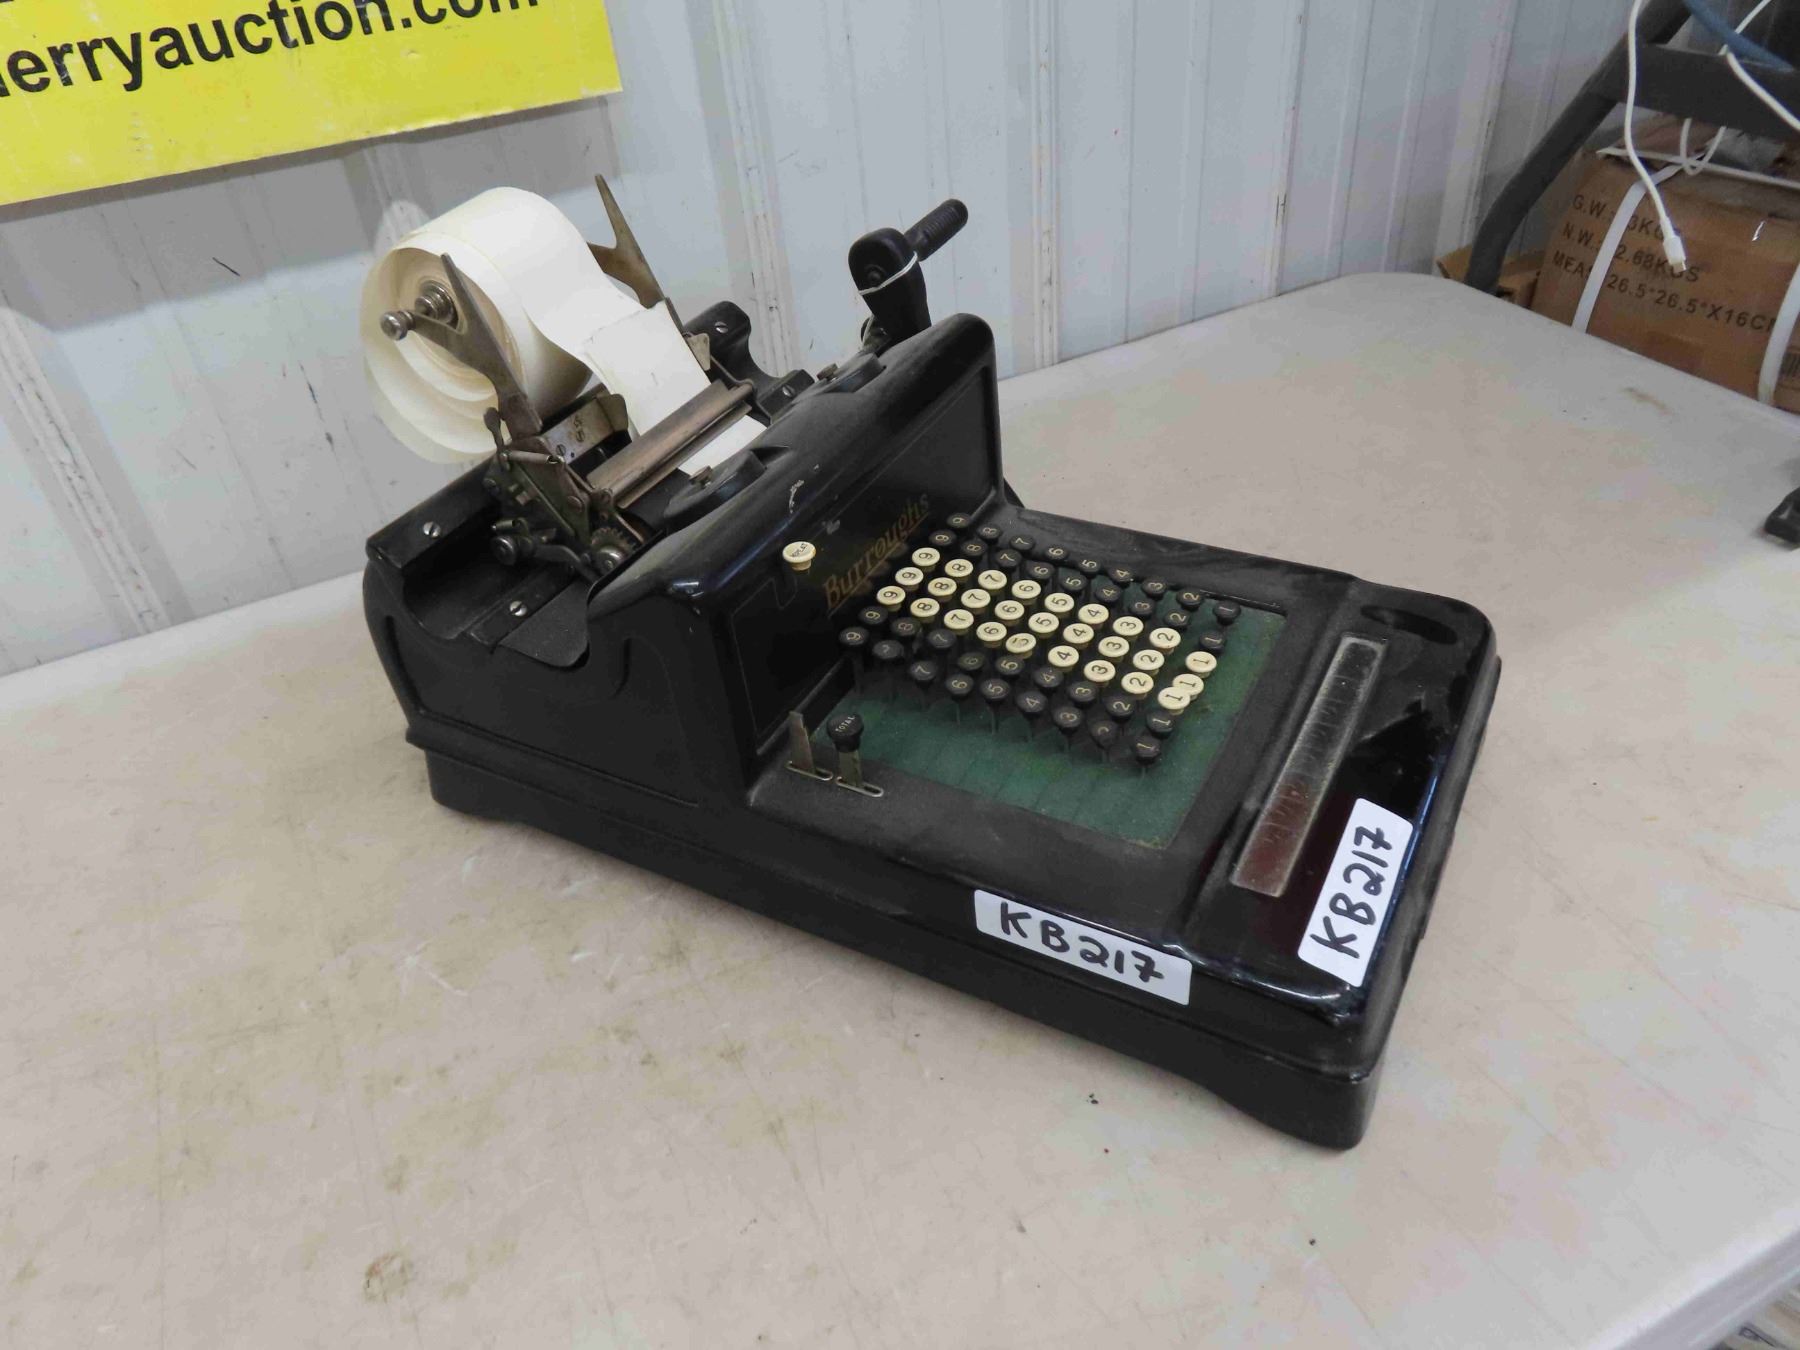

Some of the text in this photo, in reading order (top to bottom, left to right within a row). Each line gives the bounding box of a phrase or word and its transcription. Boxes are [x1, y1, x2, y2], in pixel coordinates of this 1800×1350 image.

[0, 0, 538, 97] erryauction.c
[982, 527, 997, 535] 8
[935, 534, 949, 542] 9
[1015, 537, 1030, 546] 7
[822, 494, 929, 610] Burroughs
[918, 552, 933, 560] 9
[1048, 547, 1064, 556] 6
[1000, 553, 1015, 562] 7
[951, 563, 966, 571] 8
[1082, 559, 1097, 569] 5
[1033, 565, 1049, 575] 6
[1116, 568, 1129, 578] 4
[901, 571, 917, 579] 9
[984, 574, 1000, 583] 7
[1065, 576, 1082, 586] 5
[1148, 581, 1163, 590] 3
[934, 582, 949, 590] 8
[1019, 584, 1034, 593] 6
[883, 590, 898, 599] 9
[1102, 587, 1116, 597] 4
[967, 593, 983, 601] 7
[1183, 592, 1199, 602] 2
[1052, 597, 1068, 607] 5
[1134, 601, 1150, 610] 3
[917, 603, 932, 611] 8
[1002, 605, 1017, 614] 6
[865, 611, 881, 620] 9
[1087, 608, 1102, 617] 4
[950, 614, 966, 622] 7
[1035, 617, 1052, 627] 5
[1169, 612, 1187, 623] 2
[898, 622, 913, 631] 8
[1120, 621, 1136, 630] 3
[984, 626, 999, 635] 6
[1072, 627, 1088, 637] 4
[846, 632, 861, 641] 9
[933, 634, 948, 642] 7
[1157, 632, 1174, 642] 2
[1204, 636, 1222, 644] 1
[1105, 641, 1122, 651] 3
[1056, 650, 1072, 660] 4
[1140, 654, 1158, 665] 2
[1001, 661, 1018, 670] 5
[1193, 658, 1210, 666] 1
[915, 666, 930, 674] 7
[1091, 664, 1108, 674] 3
[1042, 672, 1056, 683] 4
[951, 679, 968, 688] 6
[1128, 677, 1147, 688] 2
[1179, 679, 1197, 687] 1
[987, 683, 1003, 694] 5
[1075, 687, 1091, 695] 3
[1165, 693, 1183, 701] 1
[1025, 697, 1040, 707] 4
[1113, 701, 1130, 711] 2
[1059, 712, 1077, 721] 3
[1152, 717, 1171, 726] 1
[1309, 826, 1392, 959] KB217
[1000, 901, 1164, 983] KB217
